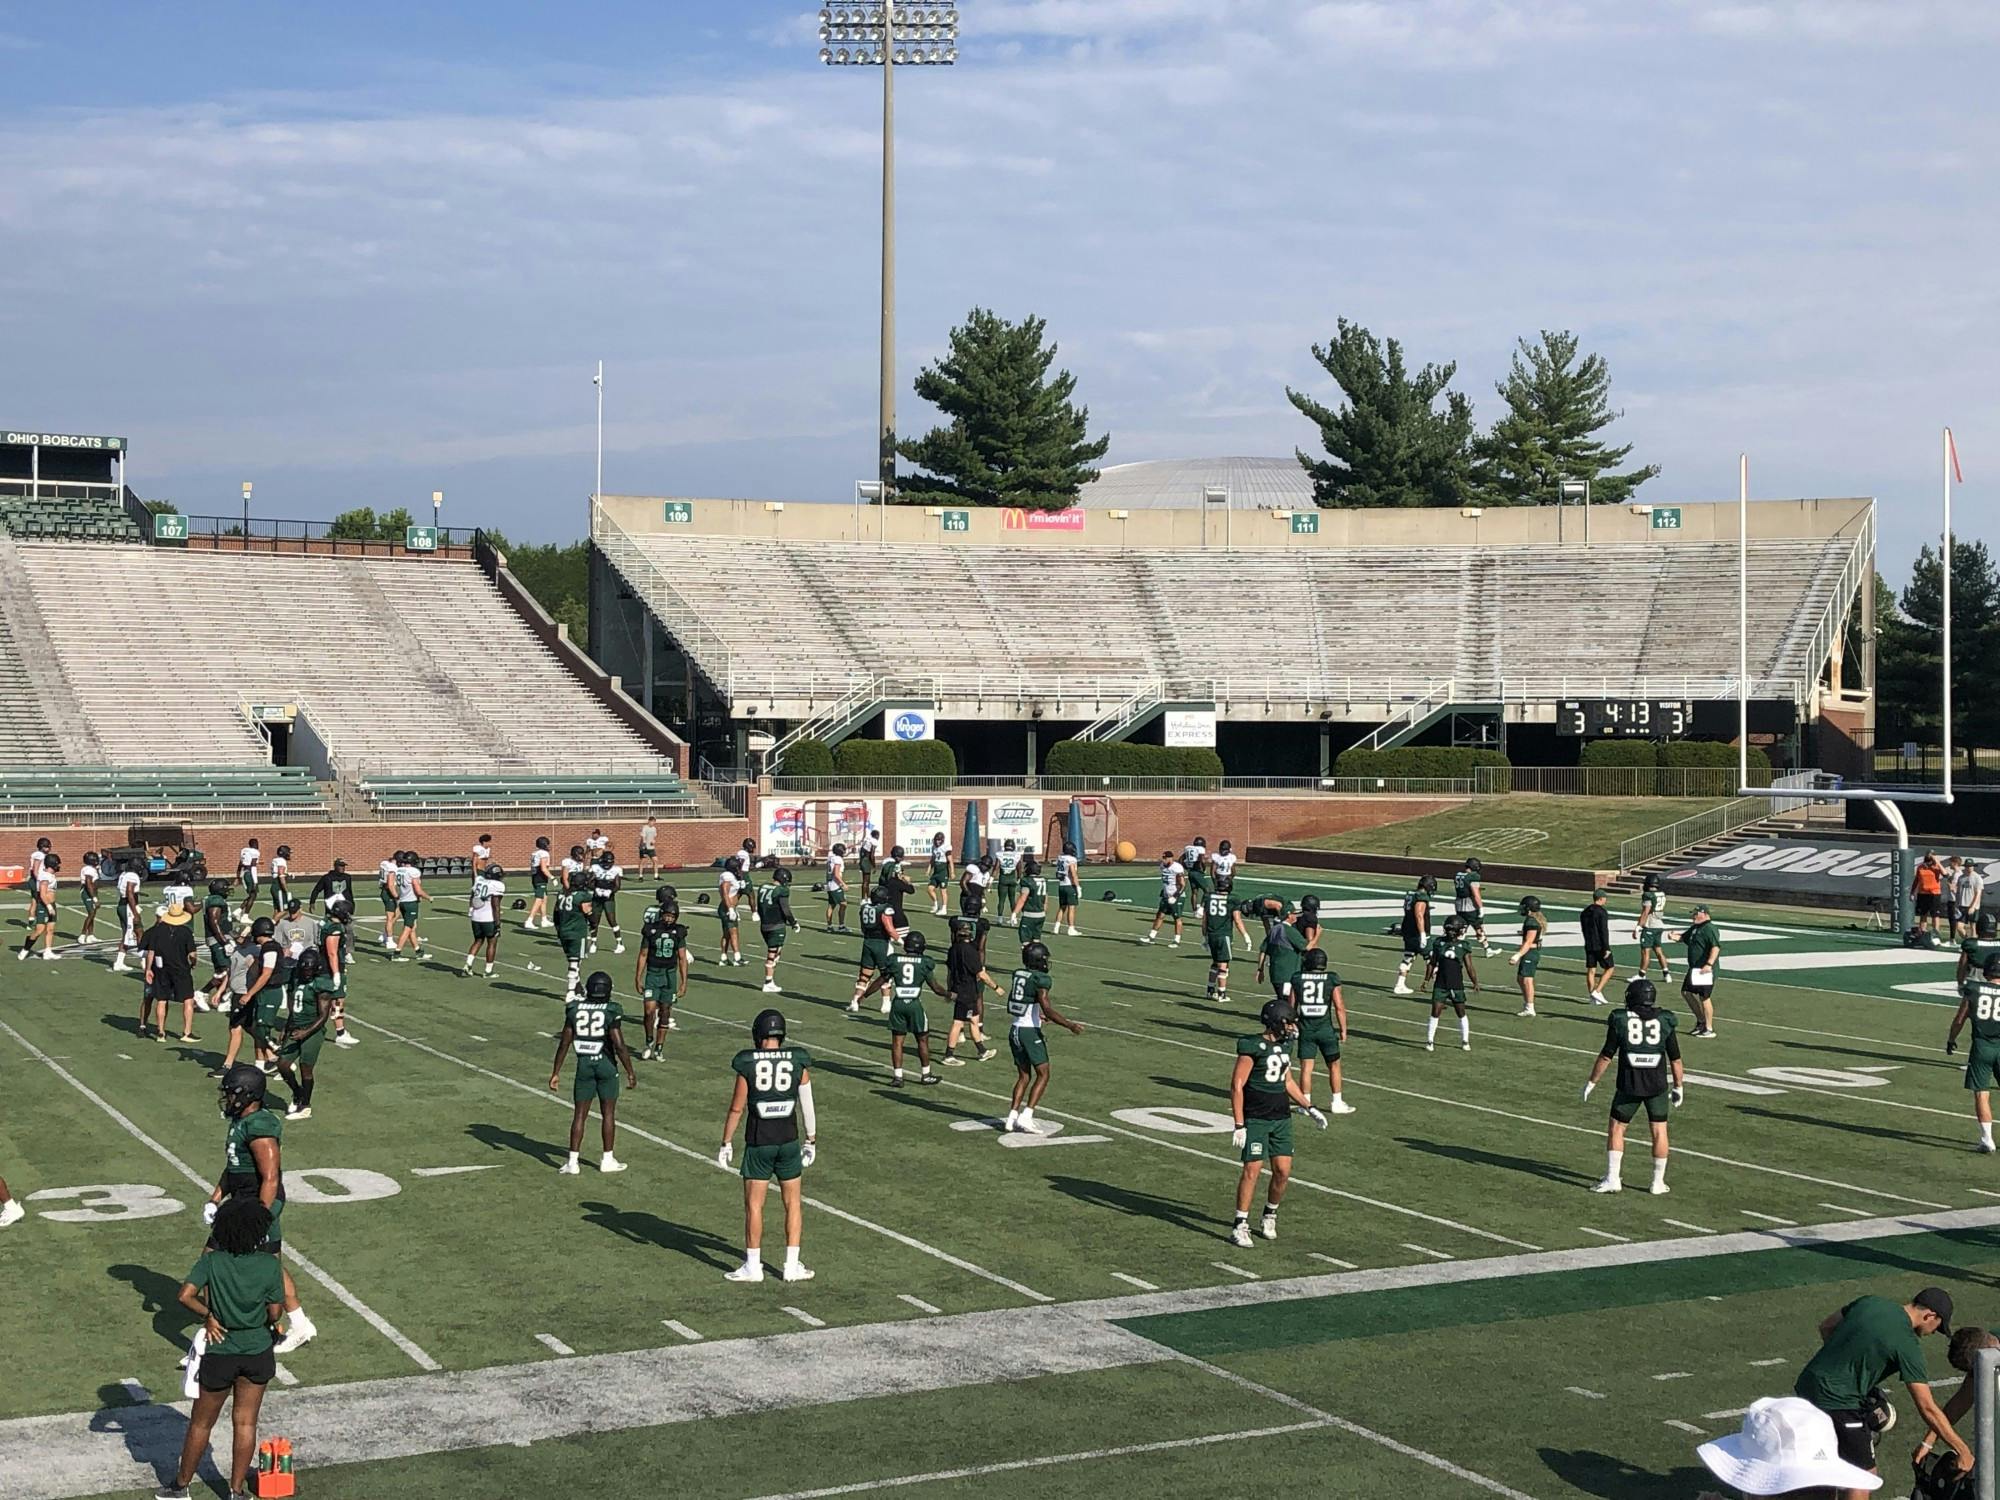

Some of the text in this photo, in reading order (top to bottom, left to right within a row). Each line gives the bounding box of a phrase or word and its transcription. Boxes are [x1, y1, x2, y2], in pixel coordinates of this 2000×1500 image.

[7, 433, 102, 448] OHIO BOBCATS
[668, 512, 688, 522] 109
[1657, 517, 1676, 528] 112
[161, 525, 183, 537] 107
[947, 521, 965, 530] 110
[1296, 522, 1314, 532] 111
[412, 537, 432, 547] 108
[1606, 702, 1649, 724] 4:13
[896, 716, 925, 739] Kroger
[1574, 712, 1585, 734] 3
[1672, 712, 1683, 734] 3
[912, 810, 943, 821] MAC
[1003, 809, 1035, 819] MAC
[1002, 857, 1014, 868] 32
[558, 895, 572, 911] 79
[759, 888, 773, 905] 74
[1209, 900, 1227, 916] 65
[902, 963, 915, 985] 9
[1303, 981, 1325, 1004] 21
[575, 1010, 605, 1037] 22
[1627, 1018, 1661, 1045] 83
[755, 1060, 794, 1092] 86
